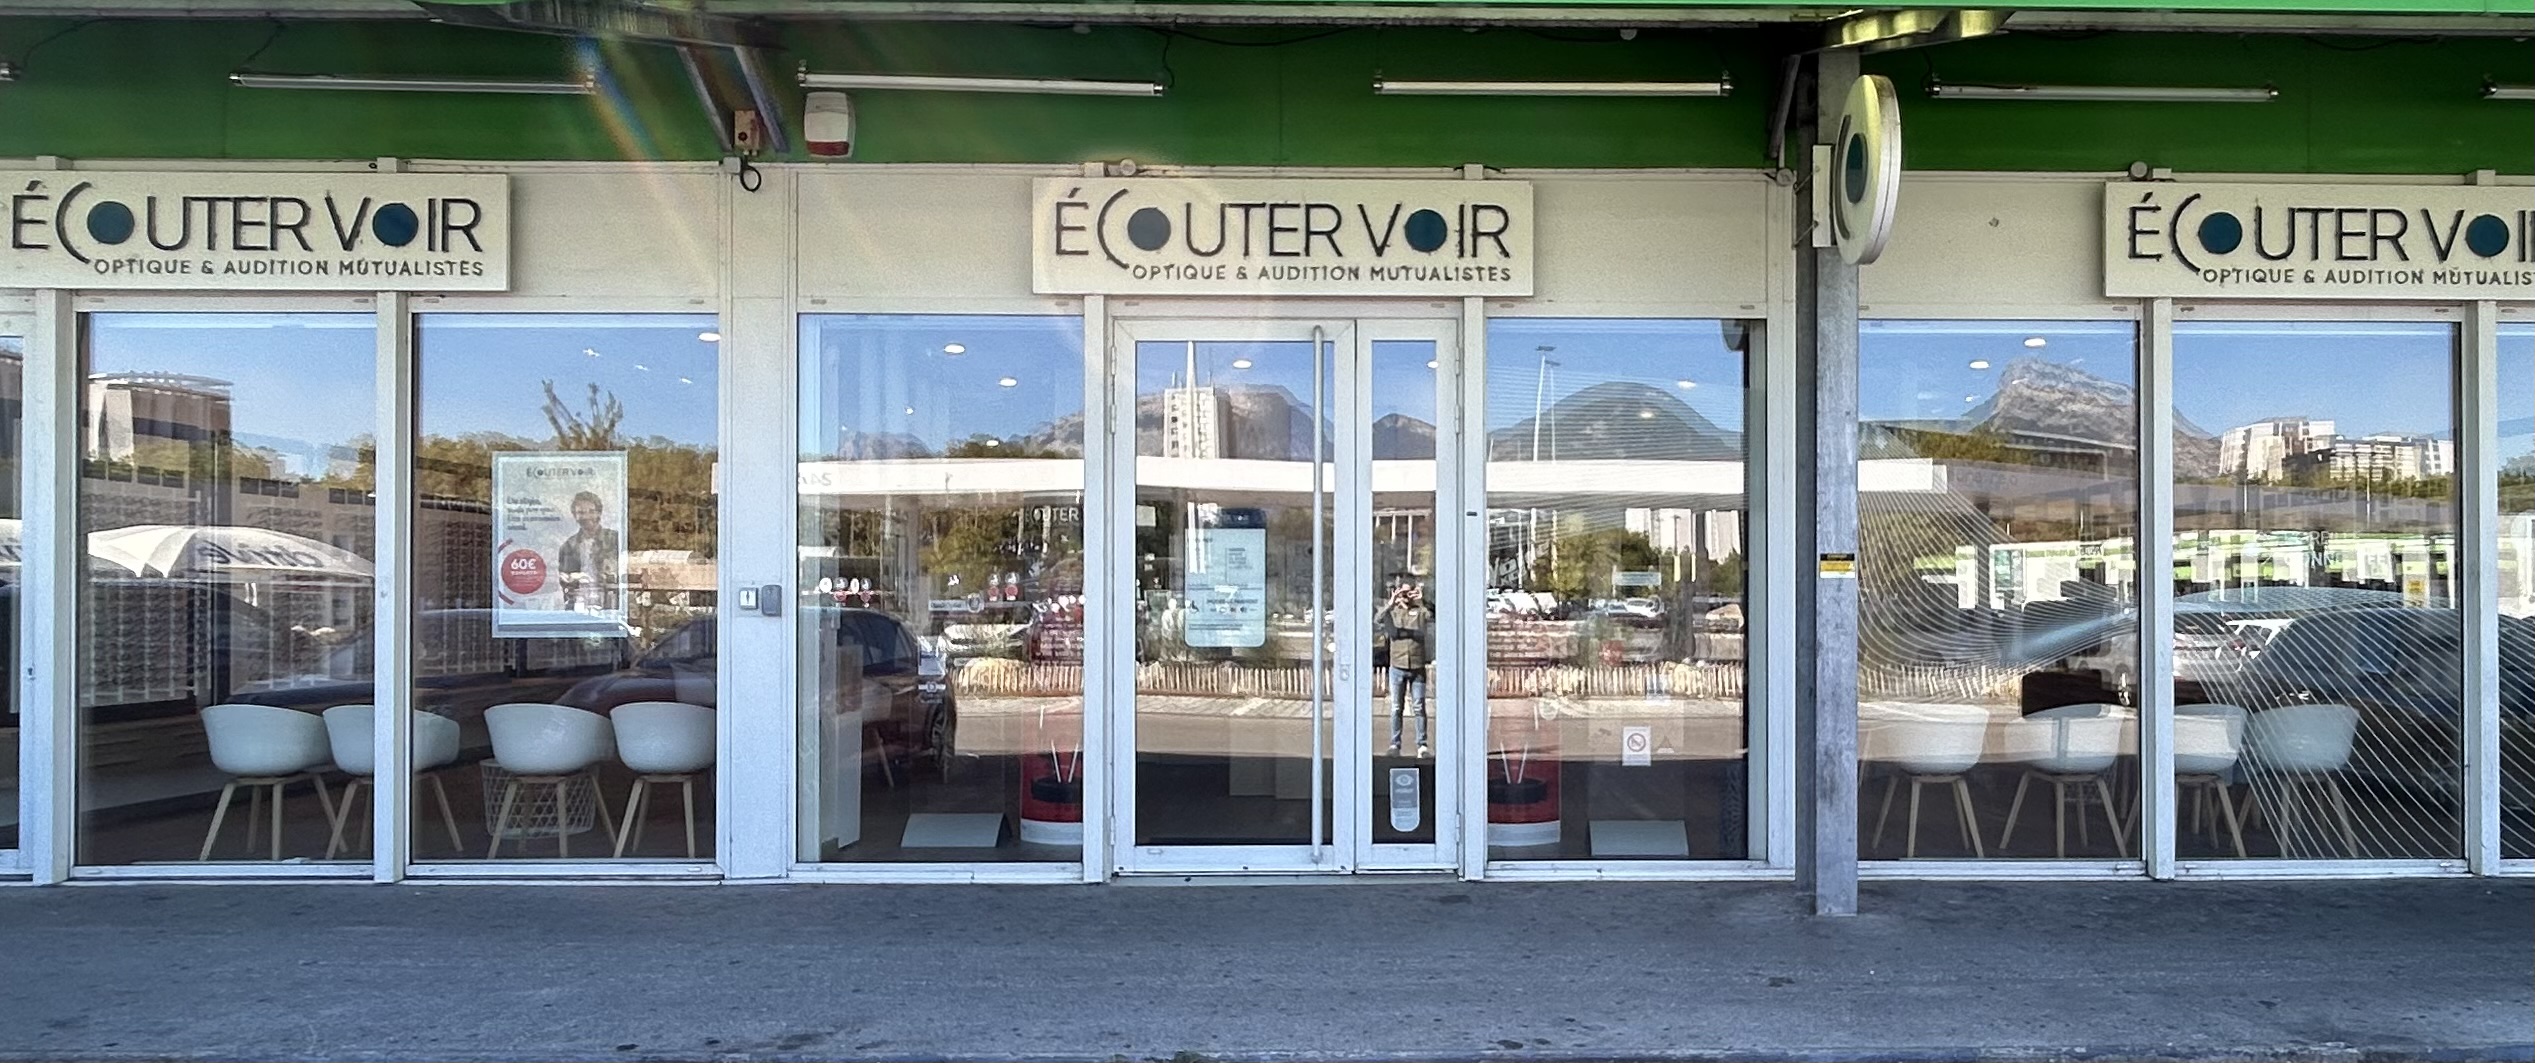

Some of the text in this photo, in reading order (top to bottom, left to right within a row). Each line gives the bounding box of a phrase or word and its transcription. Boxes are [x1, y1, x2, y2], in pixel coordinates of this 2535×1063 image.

[12, 181, 483, 263] ÉCOUTER VOIR
[1055, 188, 1511, 269] ÉCOUTER VOIR
[2127, 192, 2535, 273] ÉCOUTER VOI
[94, 259, 484, 277] OPTIQUE & AUDITION MUTUALISTES
[1132, 264, 1511, 282] OPTIQUE & AUDITION MUTUALISTES
[2203, 268, 2535, 286] OPTIQUE & AUDITION MUTUALIS
[510, 558, 537, 570] 60€
